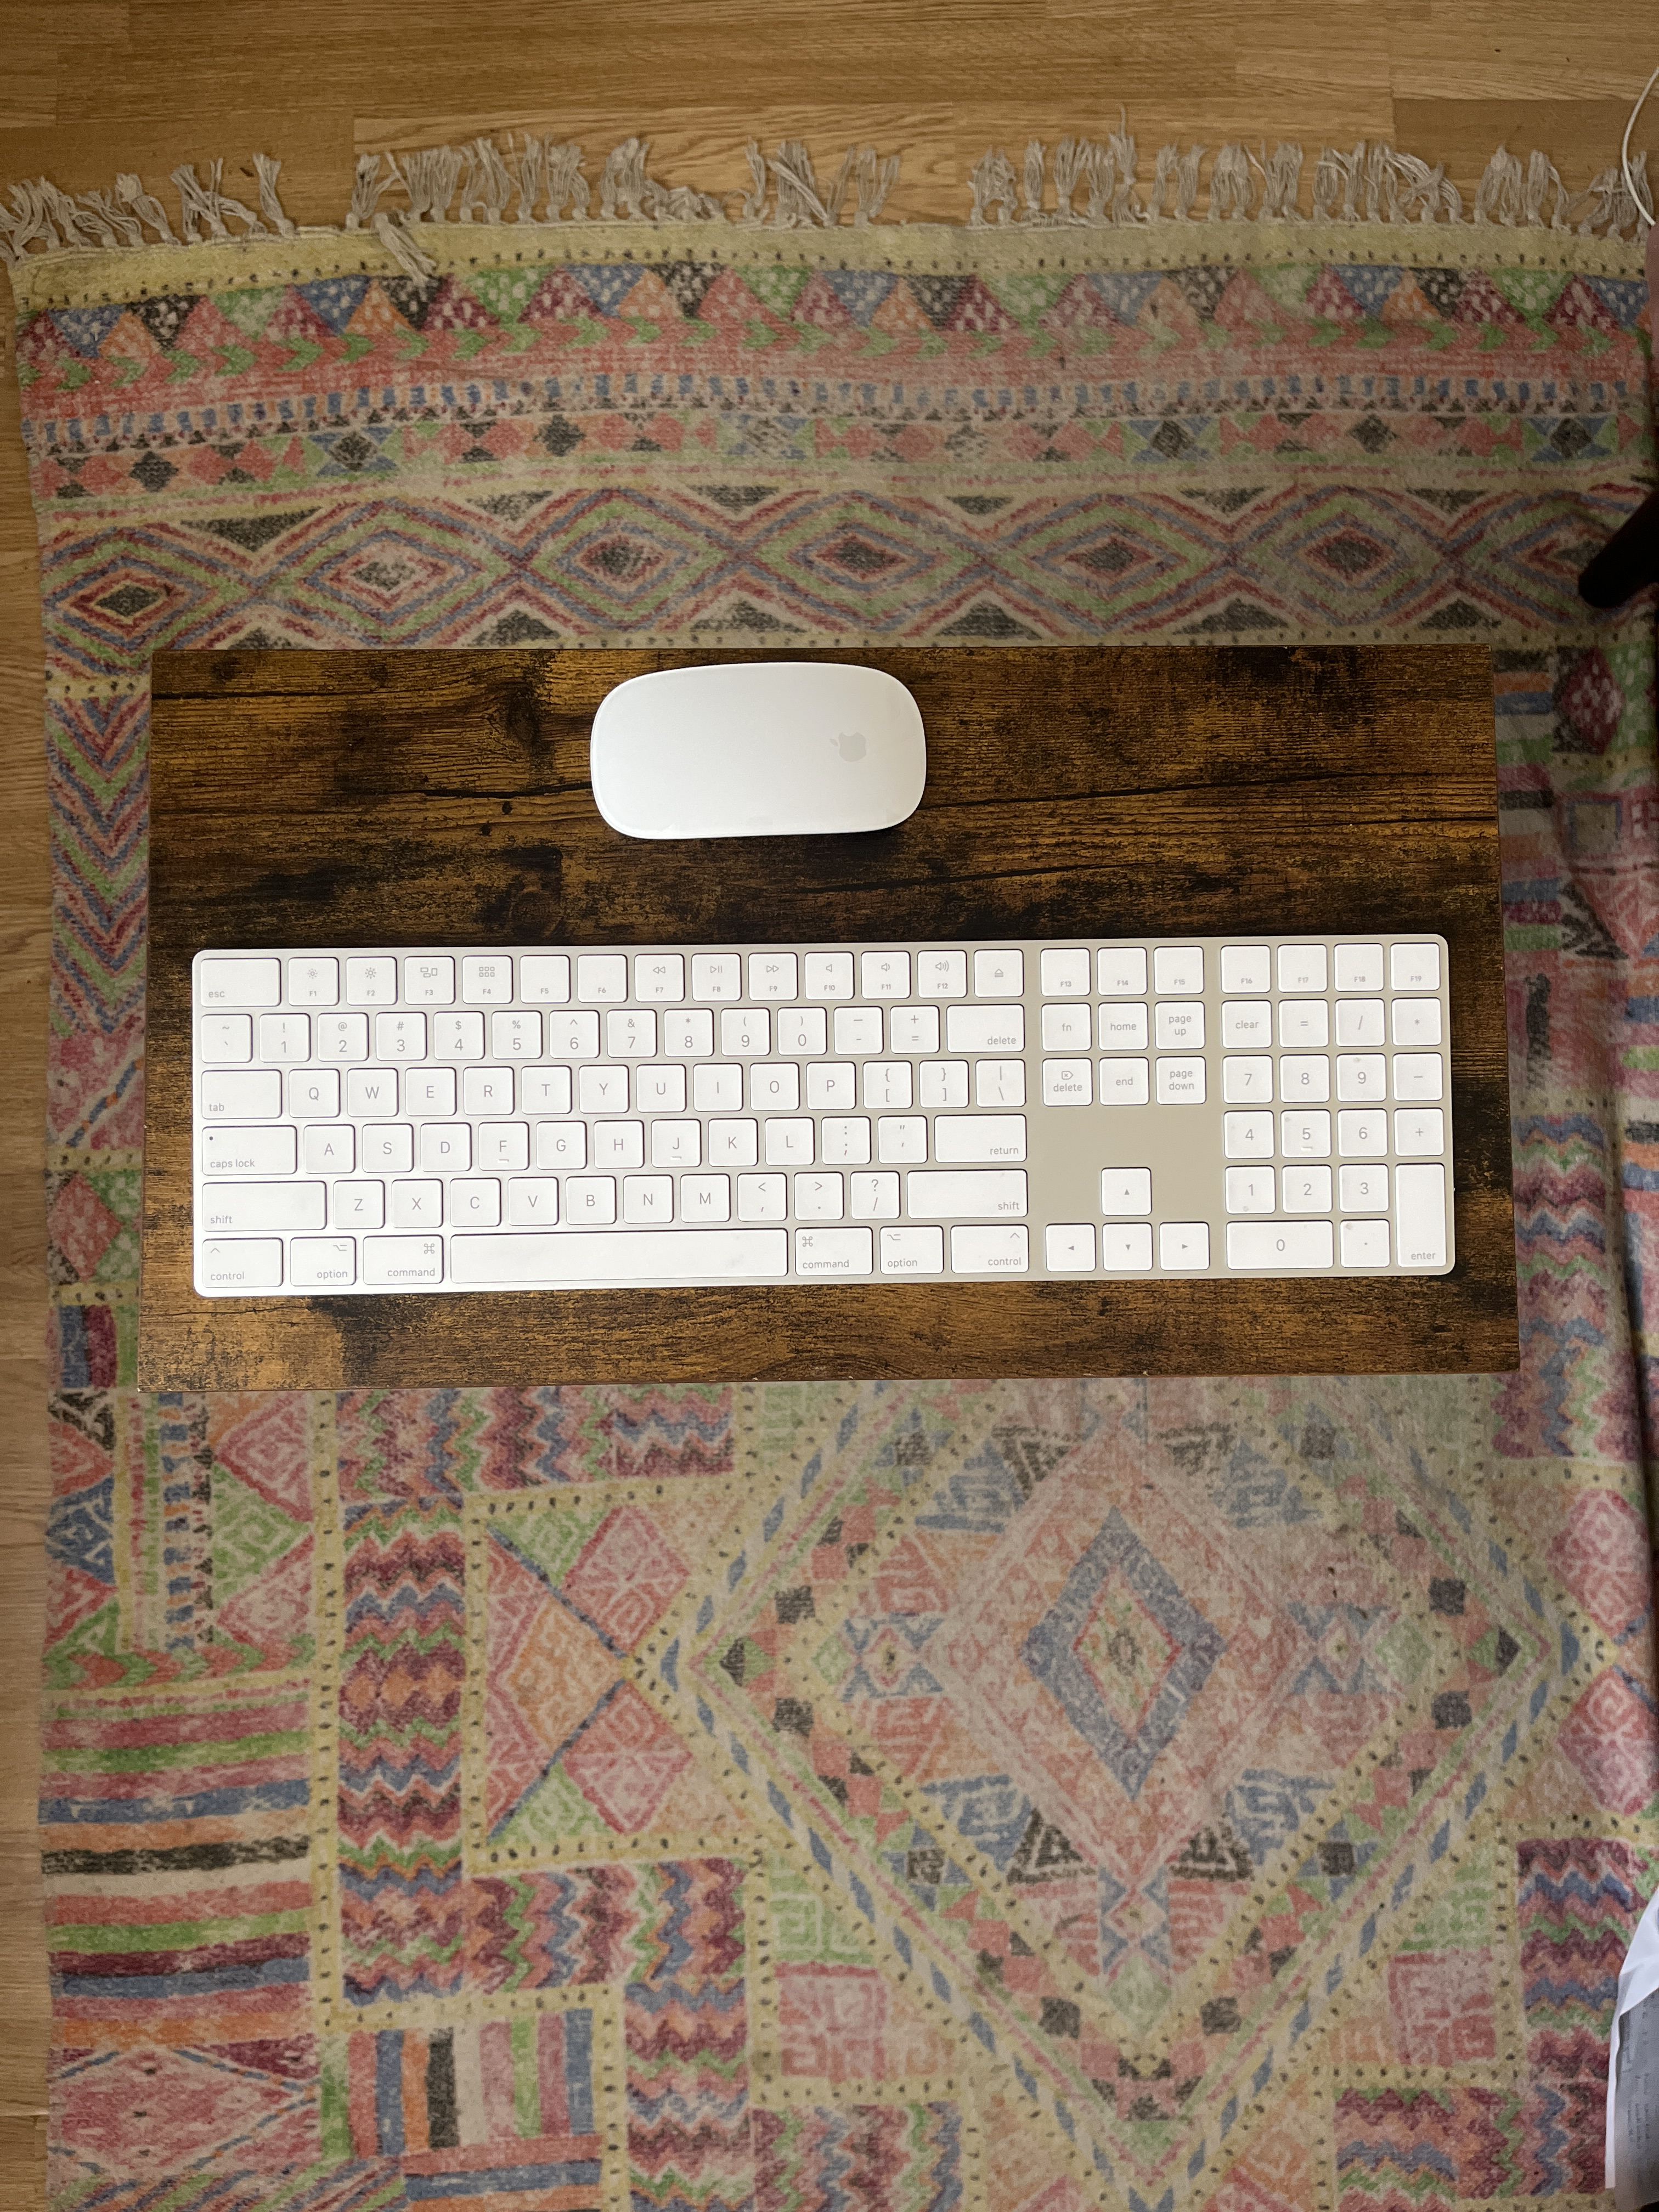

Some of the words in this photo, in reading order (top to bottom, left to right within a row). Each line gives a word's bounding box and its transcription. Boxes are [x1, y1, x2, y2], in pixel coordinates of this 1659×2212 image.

[455, 1020, 462, 1030] $
[512, 1020, 521, 1029] %
[627, 1018, 635, 1028] &
[743, 1017, 747, 1026] (
[800, 1016, 804, 1026] )
[910, 1014, 919, 1024] +
[1169, 1015, 1192, 1025] page
[1235, 1020, 1259, 1029] clear
[1357, 1015, 1363, 1030] /
[283, 1022, 285, 1033] !
[337, 1022, 347, 1032] @
[397, 1021, 404, 1031] #
[1062, 1023, 1072, 1032] fn
[1110, 1023, 1137, 1031] home
[1174, 1028, 1187, 1037] up
[281, 1041, 286, 1053] 1
[338, 1040, 347, 1053] 2
[396, 1039, 405, 1052] 3
[454, 1038, 464, 1051] 4
[512, 1037, 521, 1051] 5
[569, 1037, 579, 1050] 6
[628, 1036, 636, 1049] 7
[684, 1035, 693, 1048] 8
[741, 1035, 750, 1048] 9
[798, 1034, 807, 1047] 0
[987, 1036, 1017, 1045] delete
[884, 1068, 890, 1082] {
[941, 1067, 946, 1082] }
[1115, 1076, 1133, 1086] end
[1170, 1070, 1193, 1080] page
[1244, 1073, 1252, 1086] 7
[1301, 1072, 1310, 1085] 8
[1357, 1071, 1367, 1085] 9
[365, 1086, 380, 1099] W
[426, 1085, 435, 1098] E
[484, 1085, 493, 1098] R
[541, 1084, 551, 1097] T
[599, 1083, 608, 1096] Y
[656, 1082, 666, 1096] U
[716, 1081, 719, 1094] I
[769, 1080, 780, 1093] O
[826, 1080, 836, 1092] P
[1053, 1083, 1082, 1092] delete
[1169, 1081, 1194, 1091] down
[308, 1087, 319, 1101] Q
[885, 1088, 890, 1103] [
[942, 1087, 947, 1102] ]
[208, 1102, 225, 1111] tab
[1245, 1128, 1255, 1141] 4
[1302, 1127, 1311, 1141] 5
[1358, 1127, 1368, 1139] 6
[1415, 1127, 1424, 1137] +
[441, 1141, 450, 1154] D
[499, 1140, 507, 1153] F
[556, 1139, 566, 1152] G
[613, 1138, 624, 1151] H
[672, 1137, 680, 1150] J
[728, 1136, 737, 1149] K
[786, 1135, 794, 1148] L
[324, 1143, 334, 1156] A
[383, 1142, 392, 1155] S
[210, 1161, 233, 1170] caps
[235, 1159, 255, 1167] lock
[758, 1182, 766, 1192] <
[815, 1181, 823, 1191] >
[871, 1179, 879, 1192] ?
[1248, 1183, 1254, 1196] 1
[1303, 1183, 1312, 1196] 2
[1360, 1182, 1369, 1195] 3
[354, 1198, 364, 1211] Z
[411, 1198, 422, 1210] X
[470, 1196, 480, 1209] C
[527, 1195, 538, 1208] V
[586, 1194, 596, 1207] B
[643, 1193, 653, 1206] N
[699, 1192, 711, 1205] M
[873, 1197, 878, 1212] /
[997, 1201, 1020, 1210] shift
[210, 1215, 233, 1224] shift
[1276, 1239, 1285, 1251] 0
[988, 1257, 1022, 1266] control
[1410, 1252, 1436, 1260] enter
[802, 1259, 849, 1269] command
[887, 1258, 918, 1269] option
[210, 1271, 245, 1281] control
[317, 1270, 348, 1280] option
[387, 1267, 435, 1277] command
